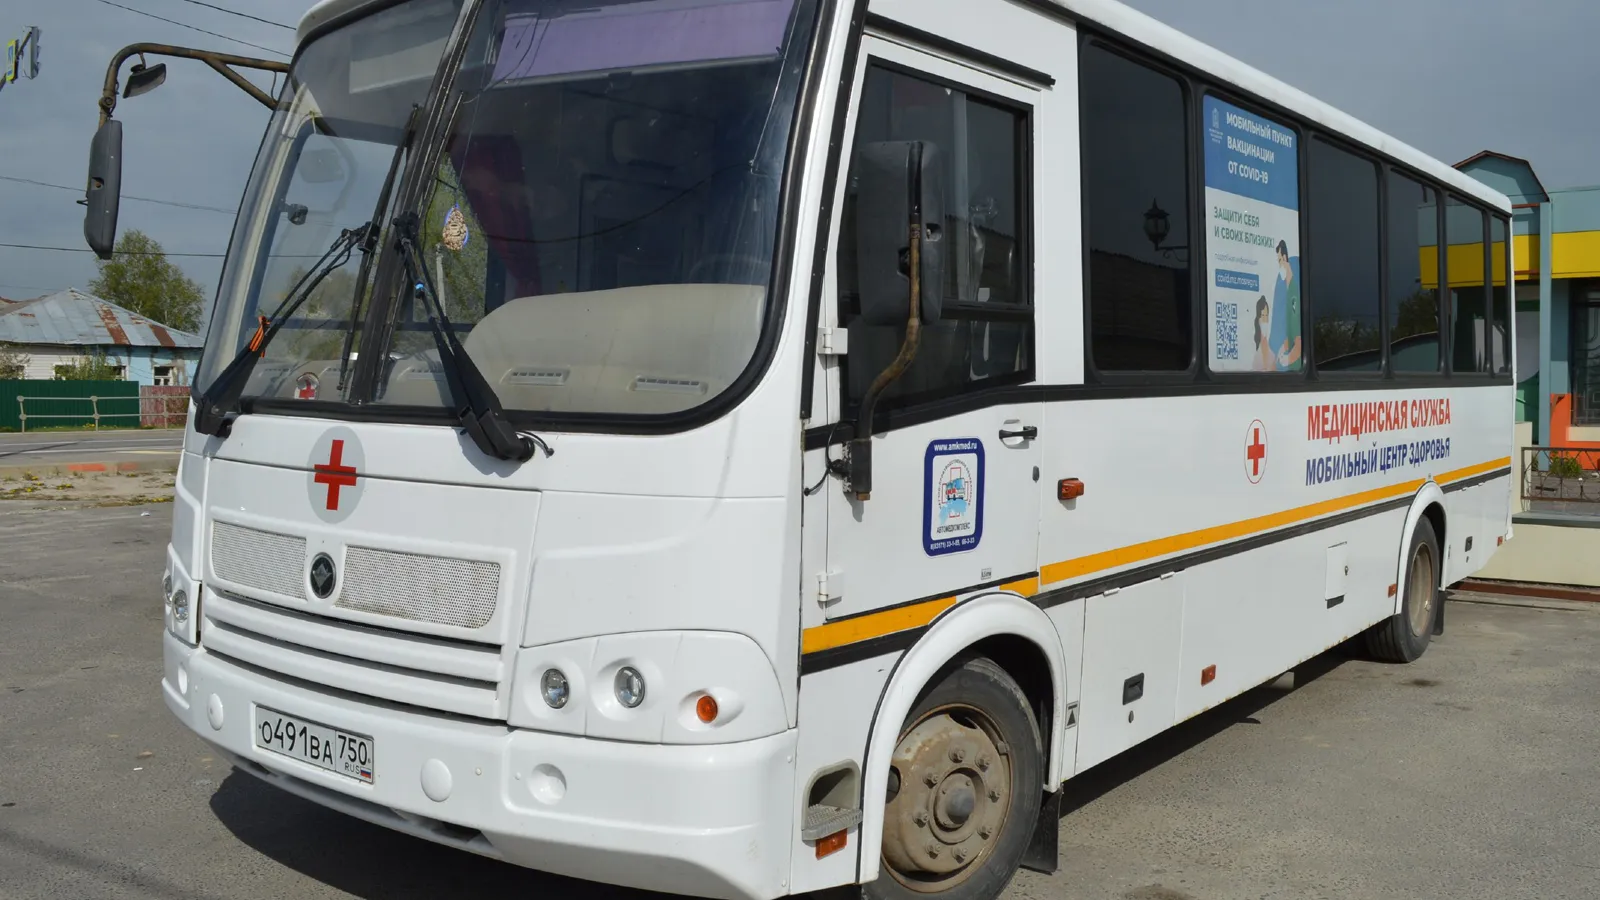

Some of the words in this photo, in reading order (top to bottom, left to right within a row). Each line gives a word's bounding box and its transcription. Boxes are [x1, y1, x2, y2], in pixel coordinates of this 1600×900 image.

[1226, 111, 1271, 140] МОБИЛЬНЫЙ
[1271, 130, 1292, 148] ПУНКТ
[1227, 135, 1275, 164] ВАКЦИНАЦИИ
[1228, 160, 1238, 175] ОТ
[1239, 164, 1269, 184] COVID-19
[1213, 206, 1242, 224] ЗАЩИТИ
[1243, 213, 1260, 228] СЕБЯ
[1214, 225, 1220, 238] И
[1221, 227, 1243, 243] СВОИХ
[1244, 232, 1275, 248] БЛИЗКИХ!
[1307, 400, 1408, 445] МЕДИЦИНСКАЯ
[1411, 398, 1451, 428] СЛУЖБА
[1305, 441, 1378, 486] МОБИЛЬНЫЙ
[1380, 444, 1408, 475] ЦЕНТР
[1409, 437, 1451, 468] ЗДОРОВЬЯ
[338, 735, 368, 766] 750
[344, 762, 360, 775] RUS
